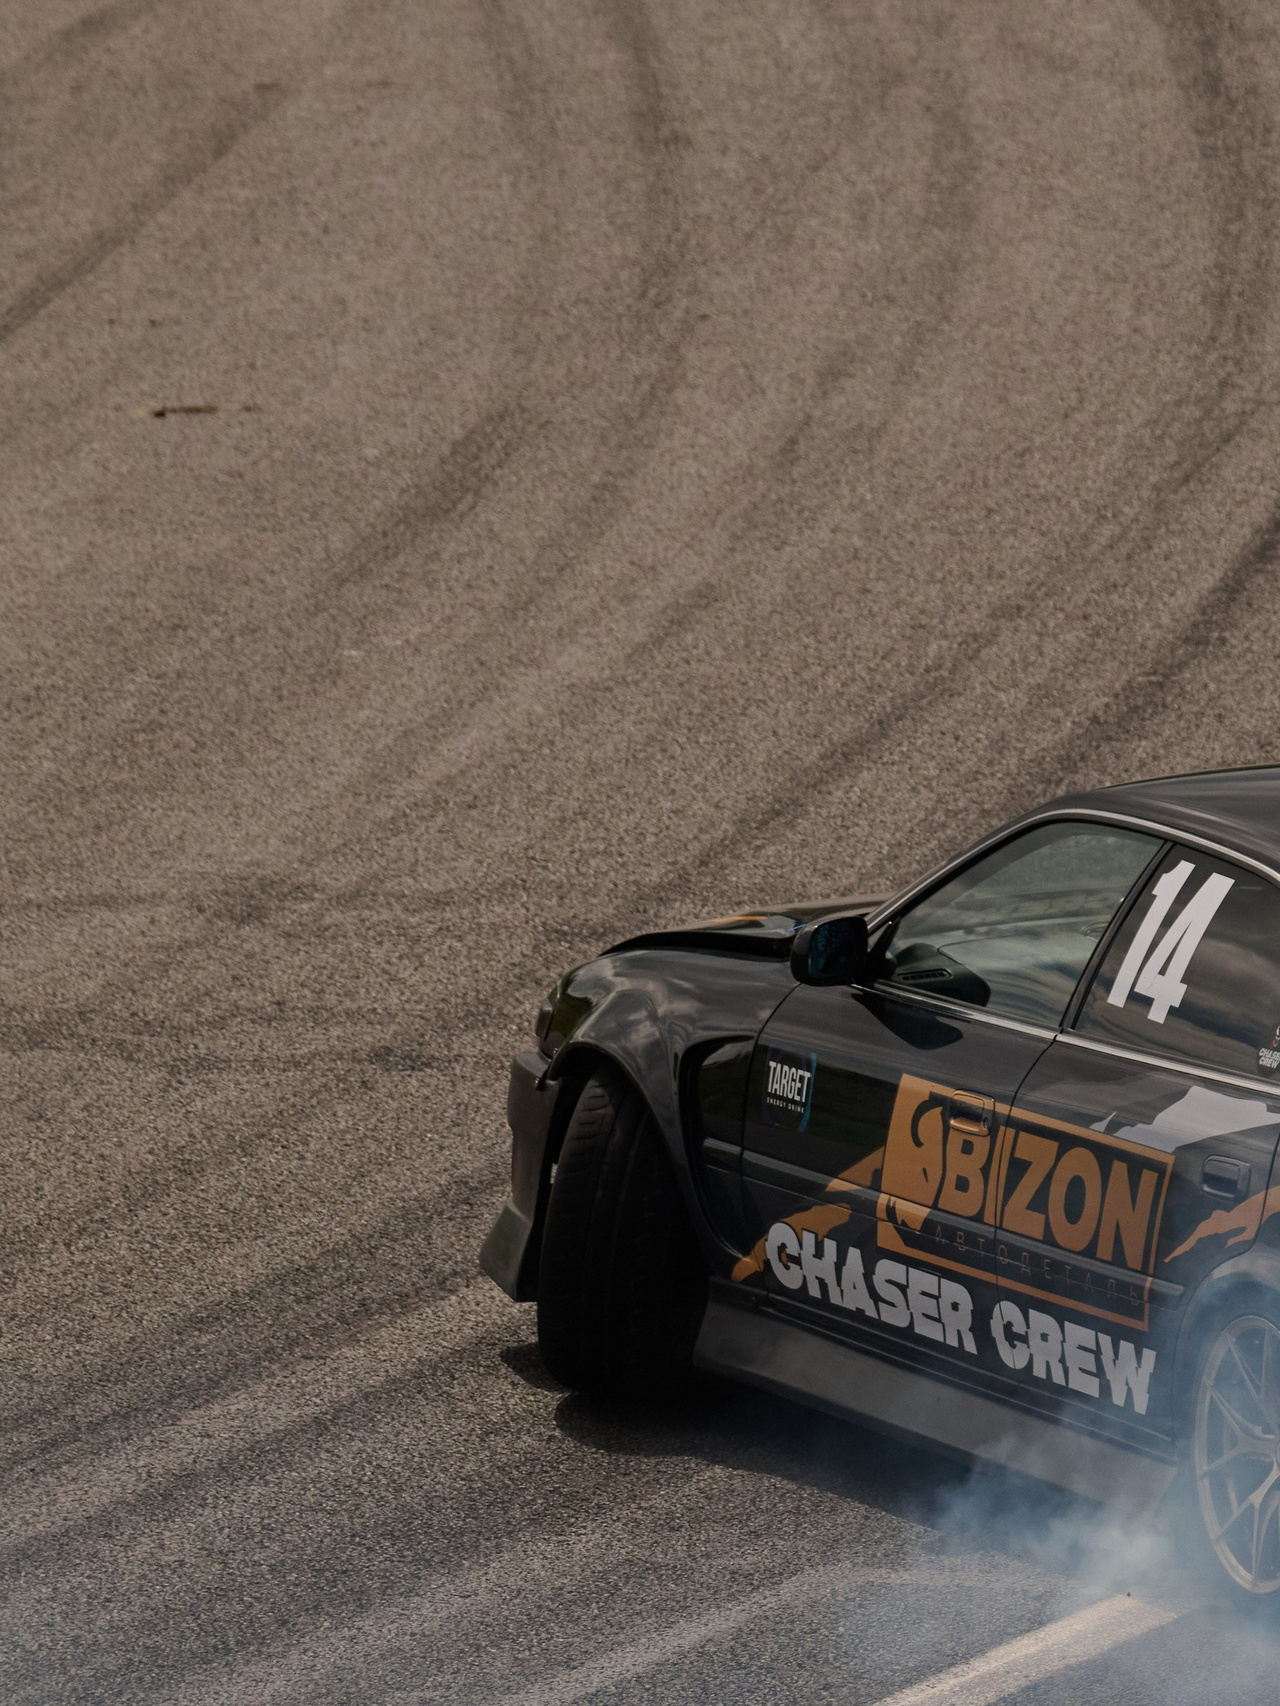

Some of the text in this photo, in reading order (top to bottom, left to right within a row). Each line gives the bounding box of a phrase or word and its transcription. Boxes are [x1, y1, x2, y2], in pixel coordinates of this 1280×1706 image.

[1107, 859, 1236, 1025] 14
[766, 1096, 804, 1113] ENERGY DRINK
[768, 1061, 811, 1102] TARGET
[938, 1118, 1159, 1270] BIZON
[765, 1222, 1157, 1415] CHASER CREW
